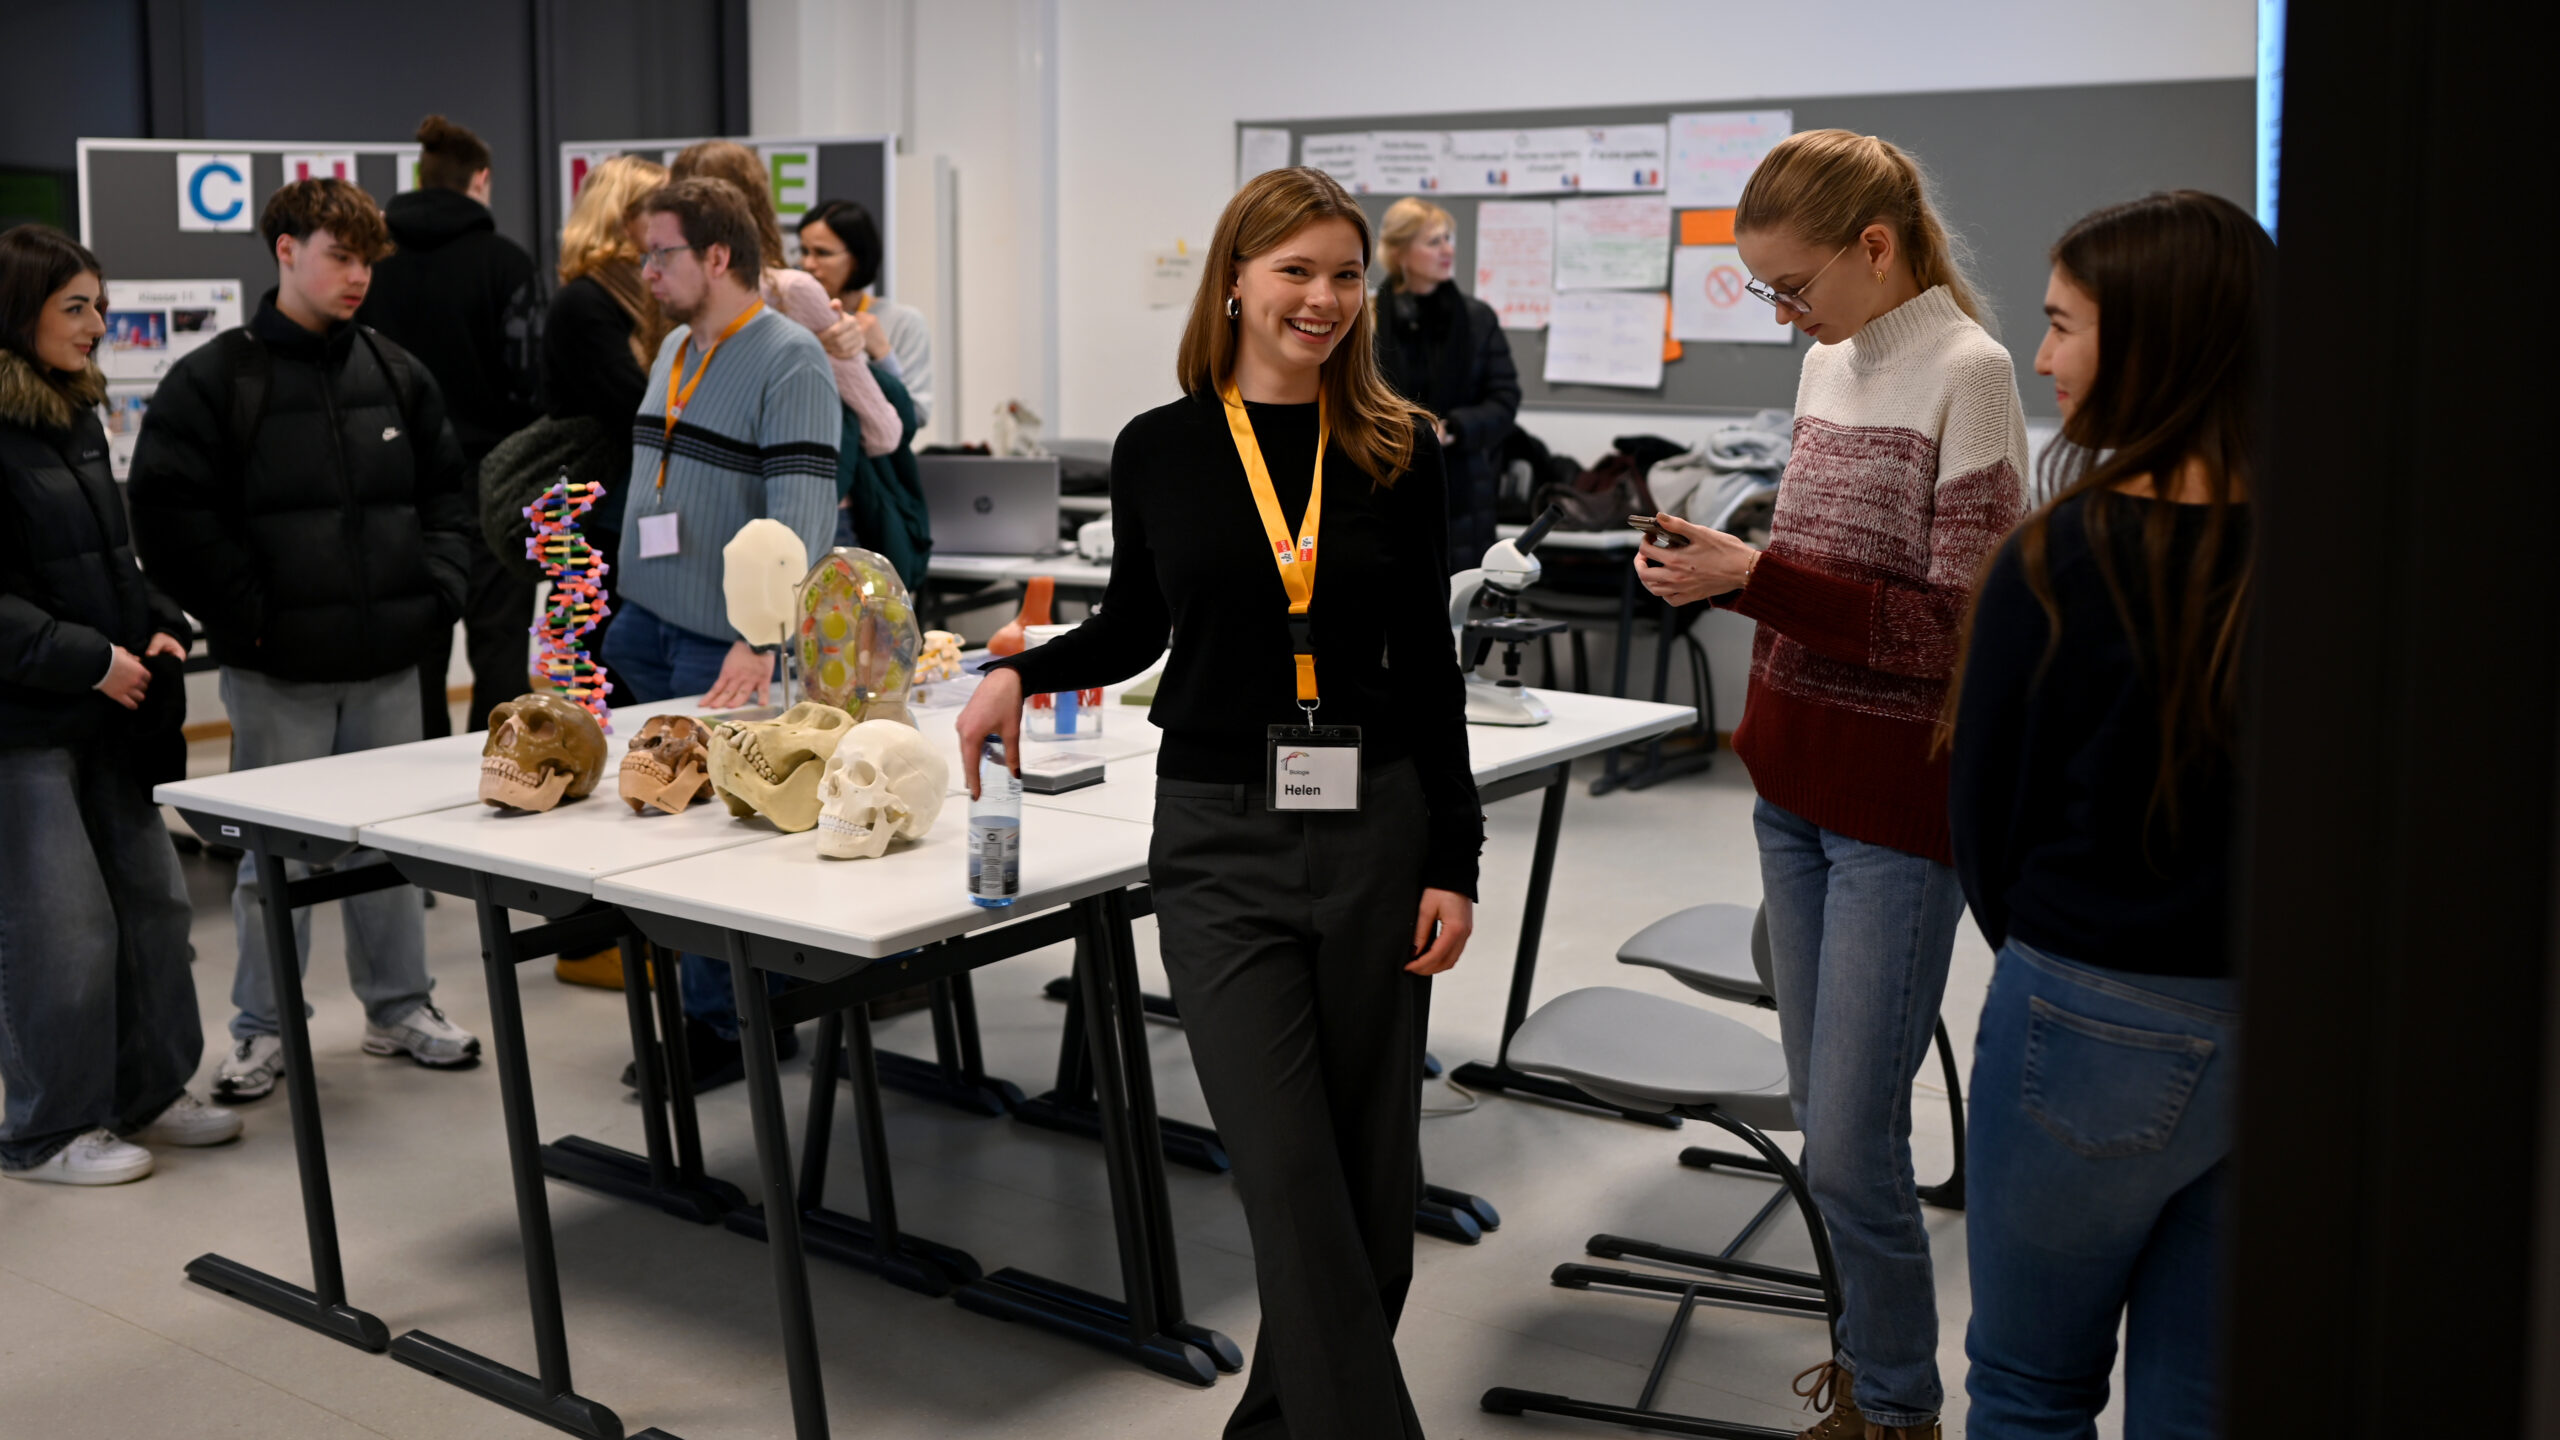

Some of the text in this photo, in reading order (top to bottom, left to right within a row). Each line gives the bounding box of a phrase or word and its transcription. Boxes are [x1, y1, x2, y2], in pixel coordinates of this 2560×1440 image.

[188, 161, 244, 222] C
[770, 153, 809, 214] E
[1285, 784, 1321, 796] Helen
